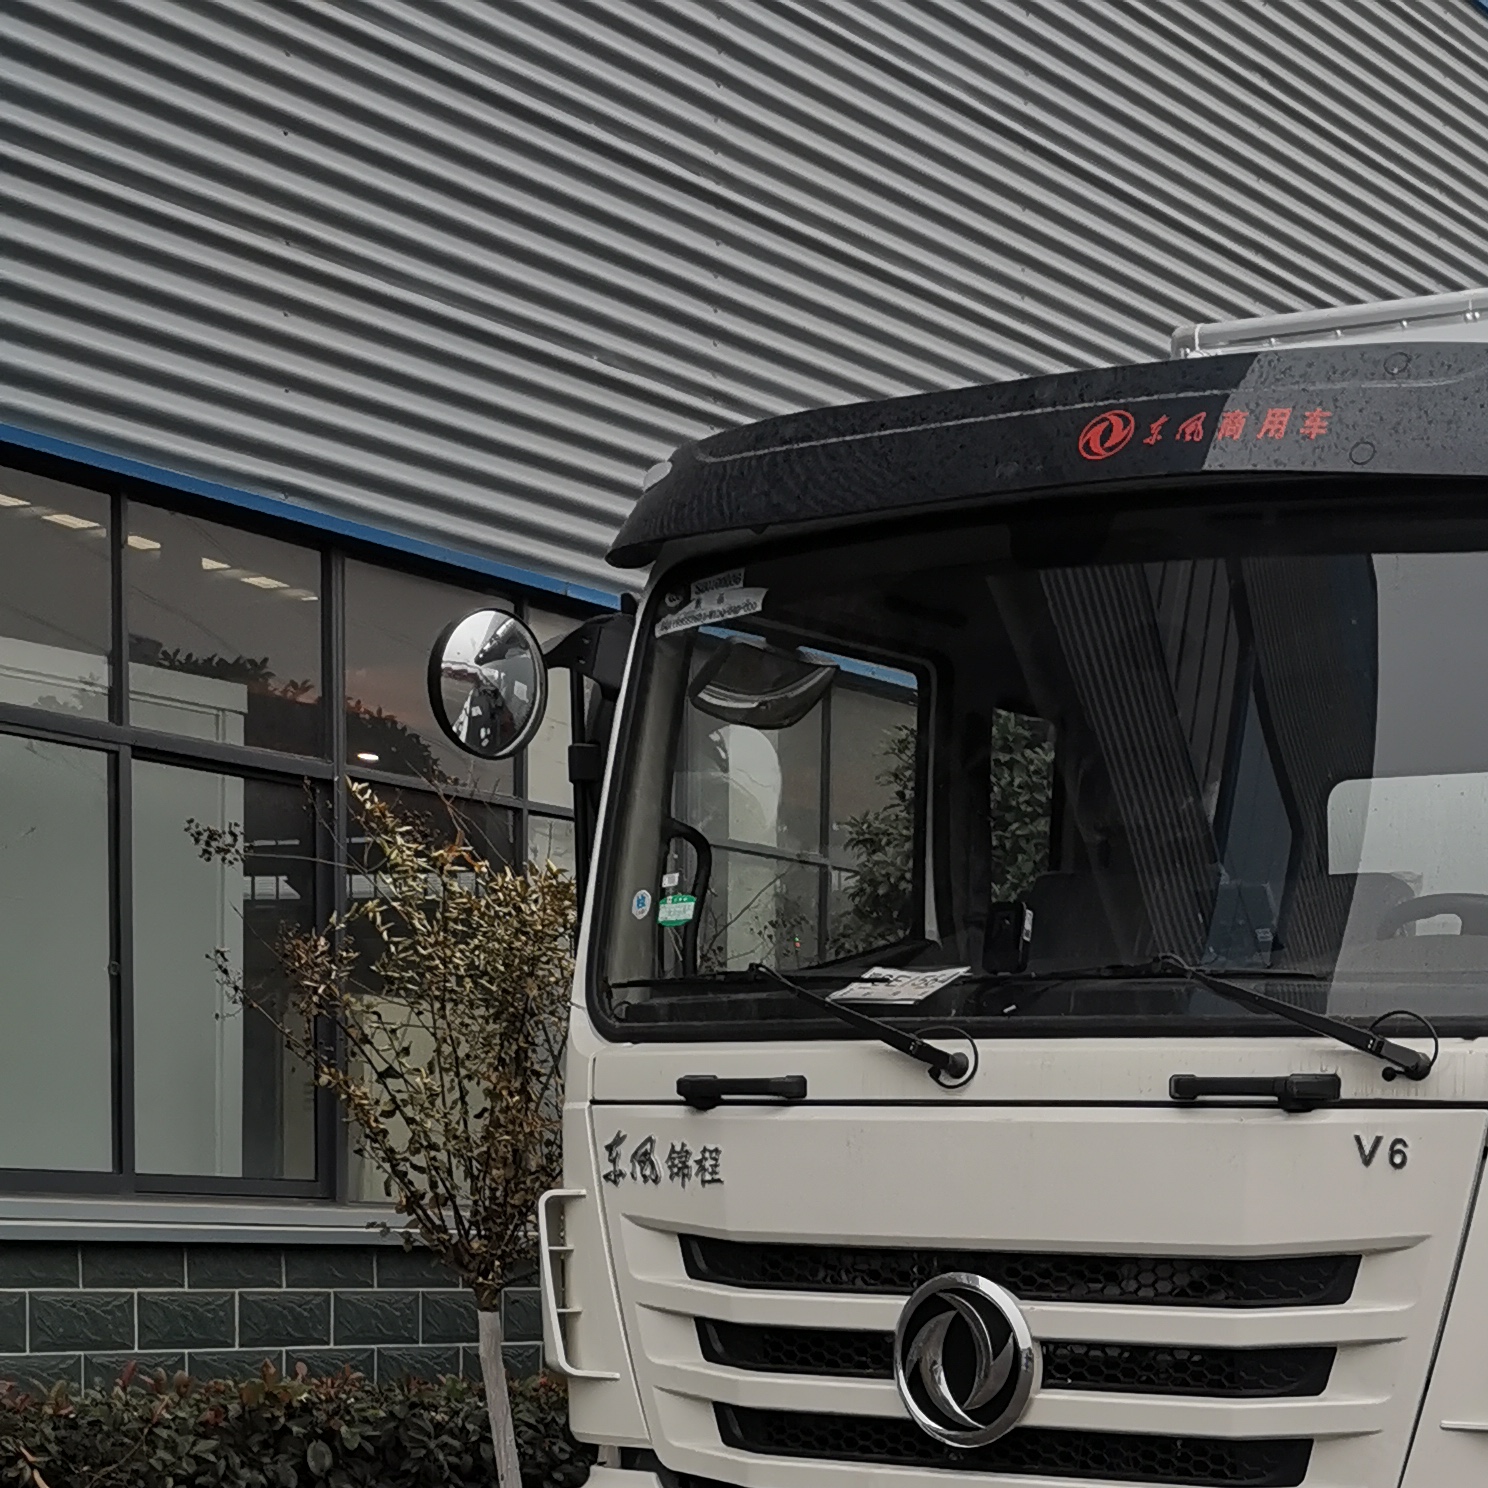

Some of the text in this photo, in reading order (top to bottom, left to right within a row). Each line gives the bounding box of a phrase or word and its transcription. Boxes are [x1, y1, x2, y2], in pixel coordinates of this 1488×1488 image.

[602, 1130, 725, 1189] 东风锦程
[1353, 1134, 1409, 1170] V6
